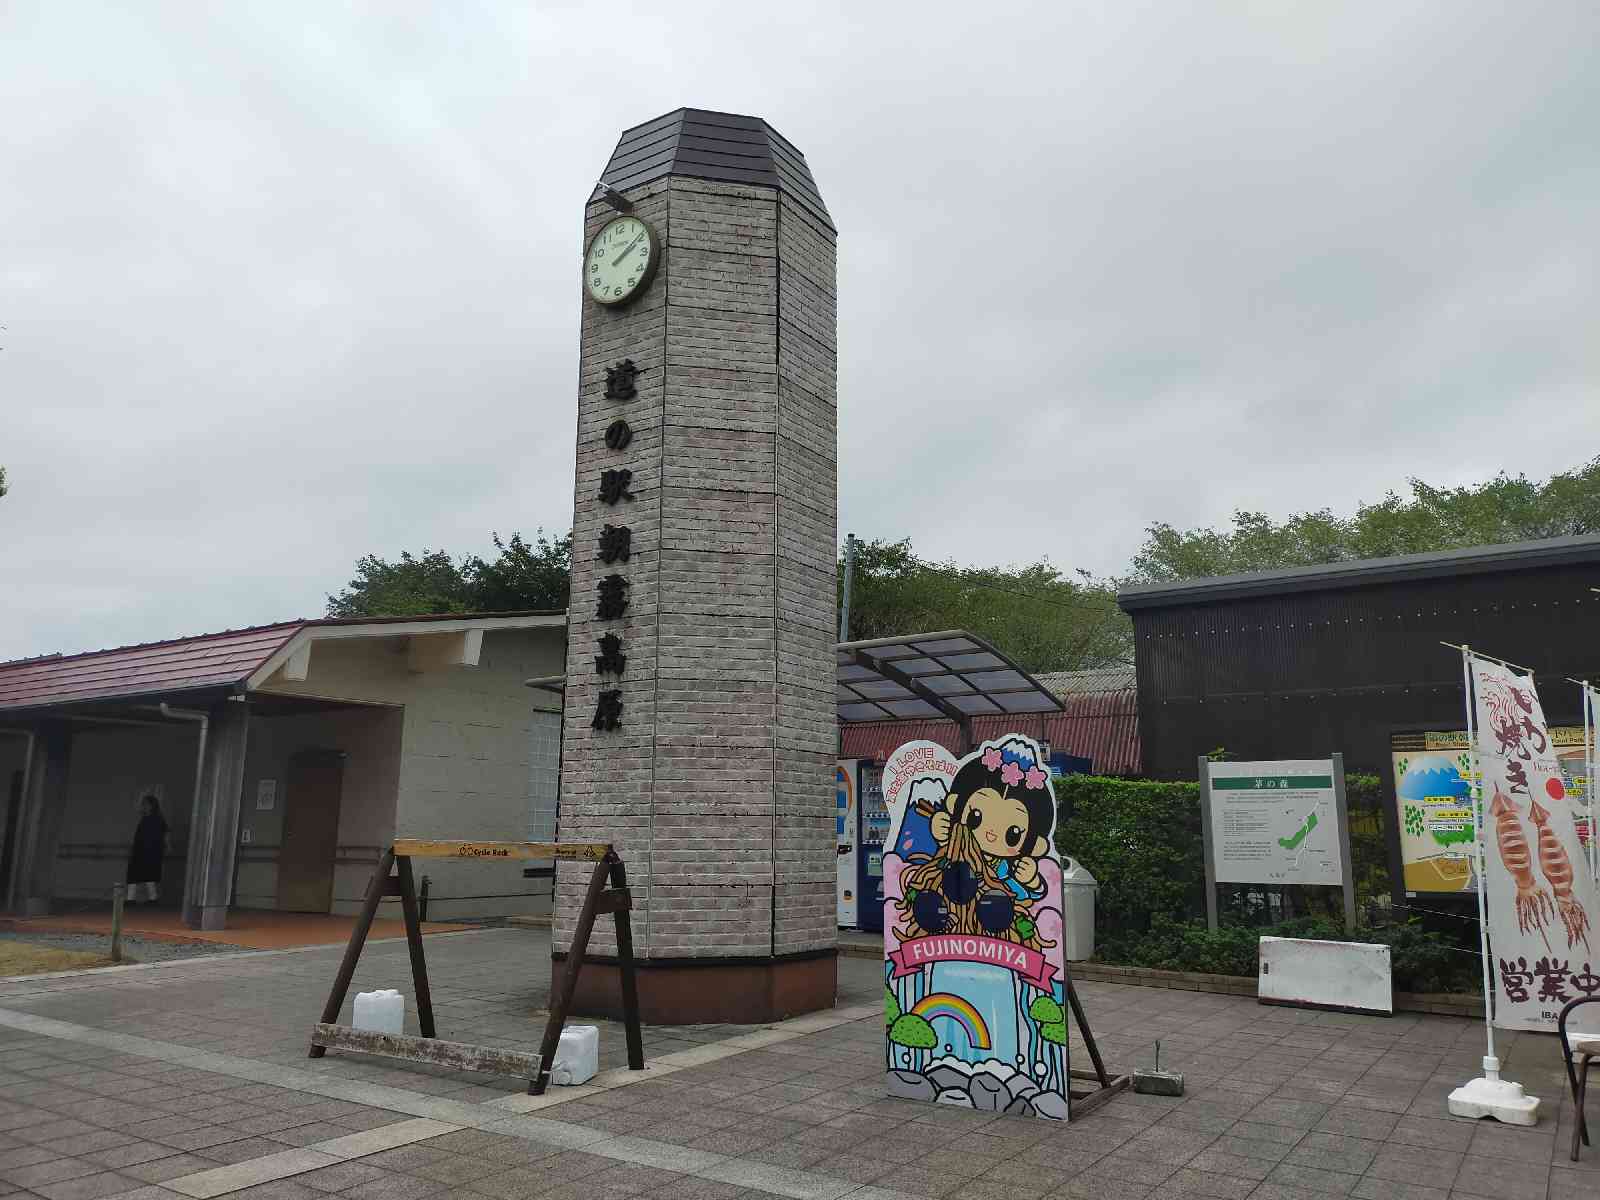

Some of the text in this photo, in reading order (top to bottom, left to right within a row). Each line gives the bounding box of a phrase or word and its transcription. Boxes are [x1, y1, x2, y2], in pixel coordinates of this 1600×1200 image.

[616, 224, 625, 235] 12
[603, 233, 612, 245] 11
[594, 248, 605, 258] 10
[640, 247, 648, 257] 3
[591, 264, 599, 273] 9
[635, 263, 644, 272] 4
[593, 278, 601, 287] 8
[628, 278, 636, 287] 5
[603, 286, 610, 295] 7
[614, 287, 622, 295] 6
[897, 747, 934, 768] LOVE
[912, 939, 1029, 969] FUJINOMIYA
[1499, 956, 1600, 1003] 営業中
